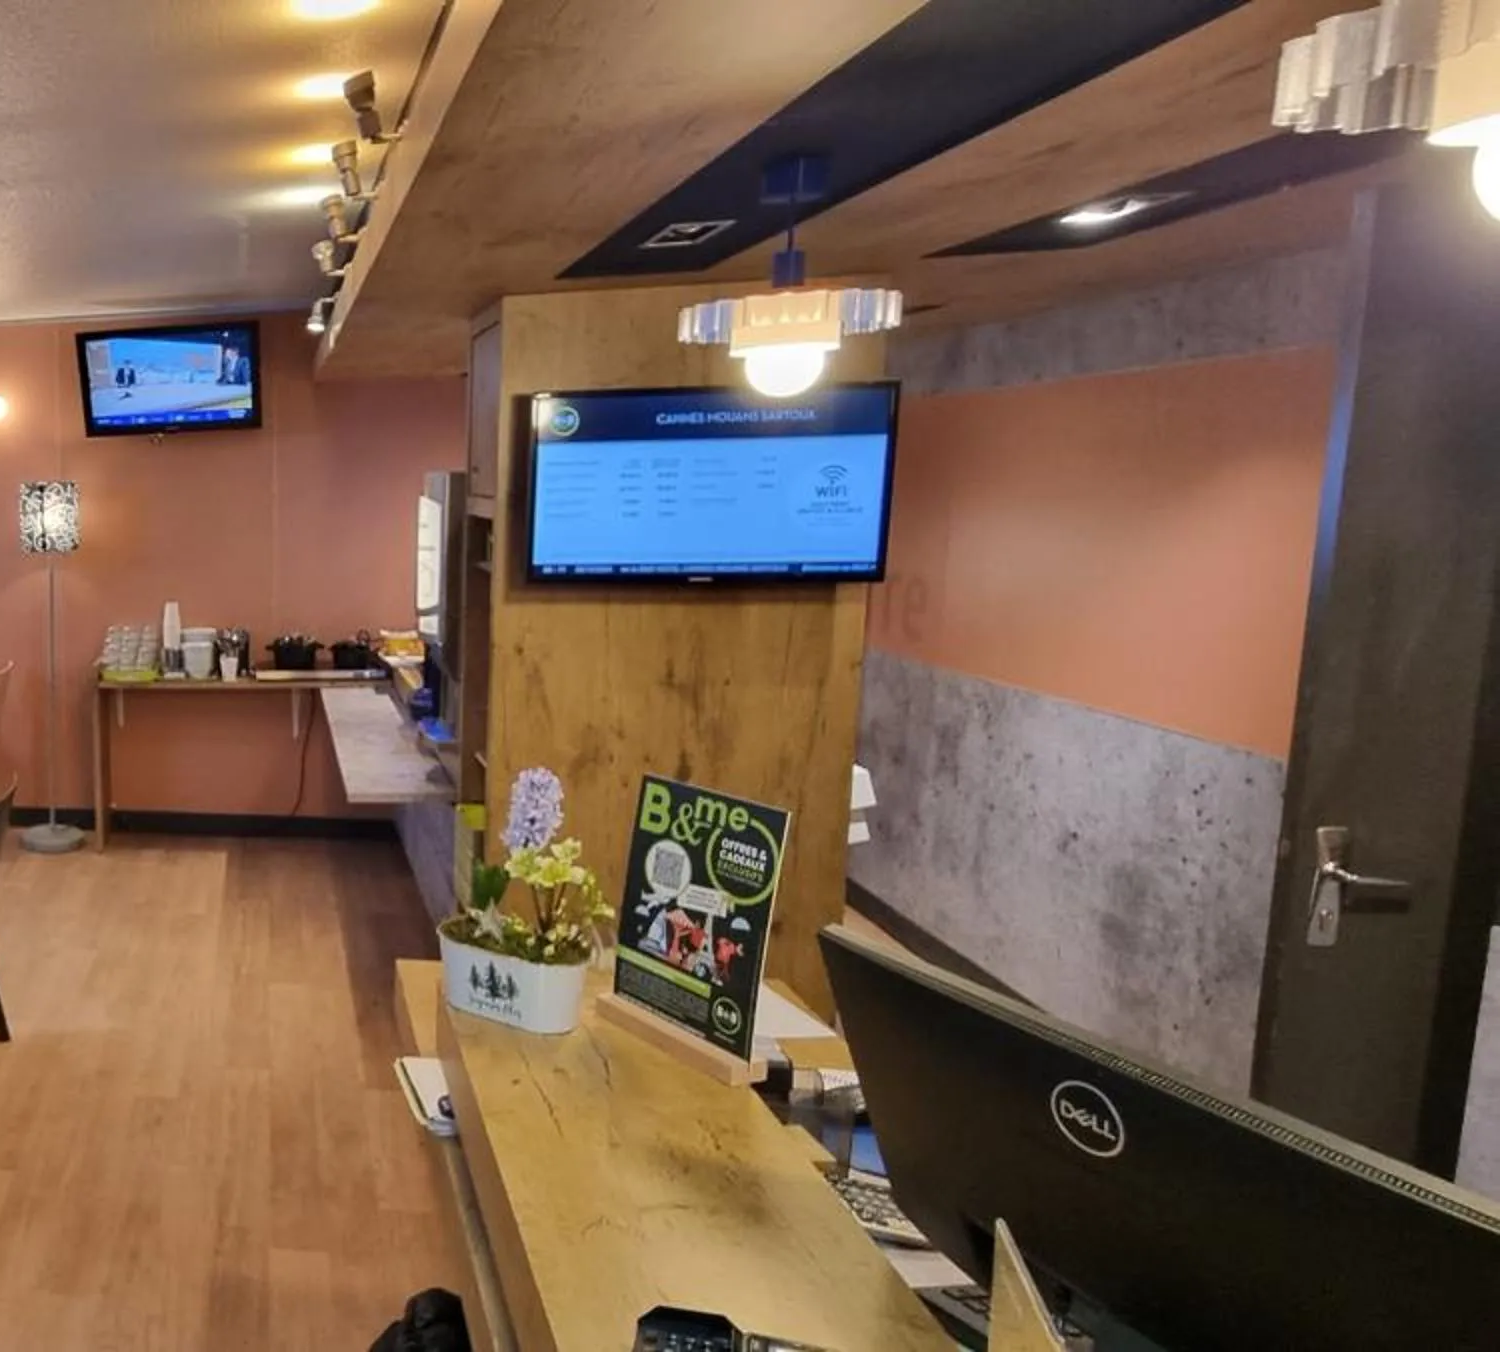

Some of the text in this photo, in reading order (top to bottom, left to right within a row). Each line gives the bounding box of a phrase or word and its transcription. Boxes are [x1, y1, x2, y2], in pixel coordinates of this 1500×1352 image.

[655, 412, 704, 426] CANNES
[719, 848, 767, 873] CADEAUX
[1059, 1098, 1117, 1142] DELL
